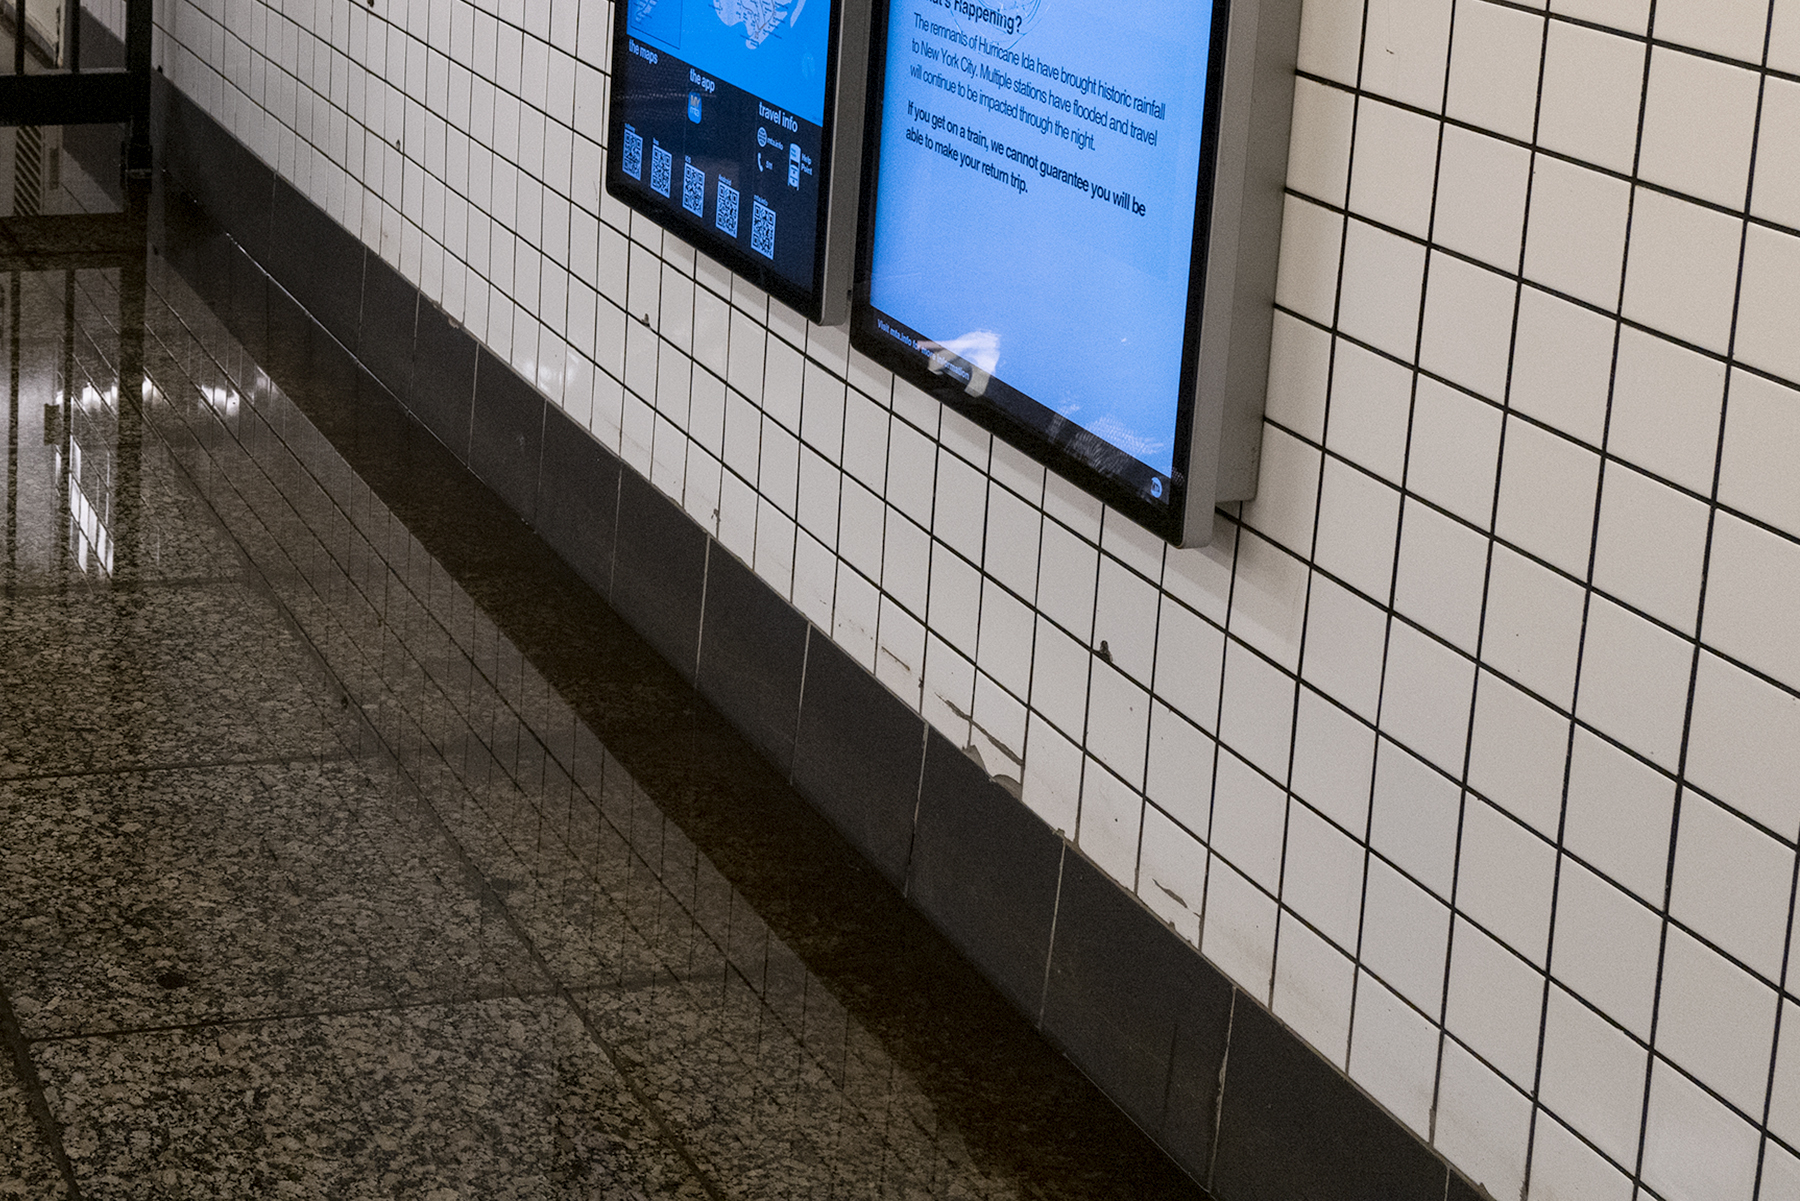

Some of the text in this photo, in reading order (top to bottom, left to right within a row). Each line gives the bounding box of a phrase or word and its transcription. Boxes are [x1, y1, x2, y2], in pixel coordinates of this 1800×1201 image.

[628, 38, 658, 65] the maps
[689, 68, 716, 94] the app
[914, 12, 1166, 120] The remnants of Hurricane Ida have brought historic rainfall
[758, 101, 782, 125] travel
[782, 112, 798, 133] info
[910, 64, 1095, 151] will continue to be impacted through the night.
[912, 38, 1158, 147] to New York City. Multiple stations have flooded and travel
[905, 126, 1028, 194] able to make your return trip.
[907, 100, 1146, 217] If you get on a train, we cannot guarantee you will be
[877, 318, 890, 333] Visit
